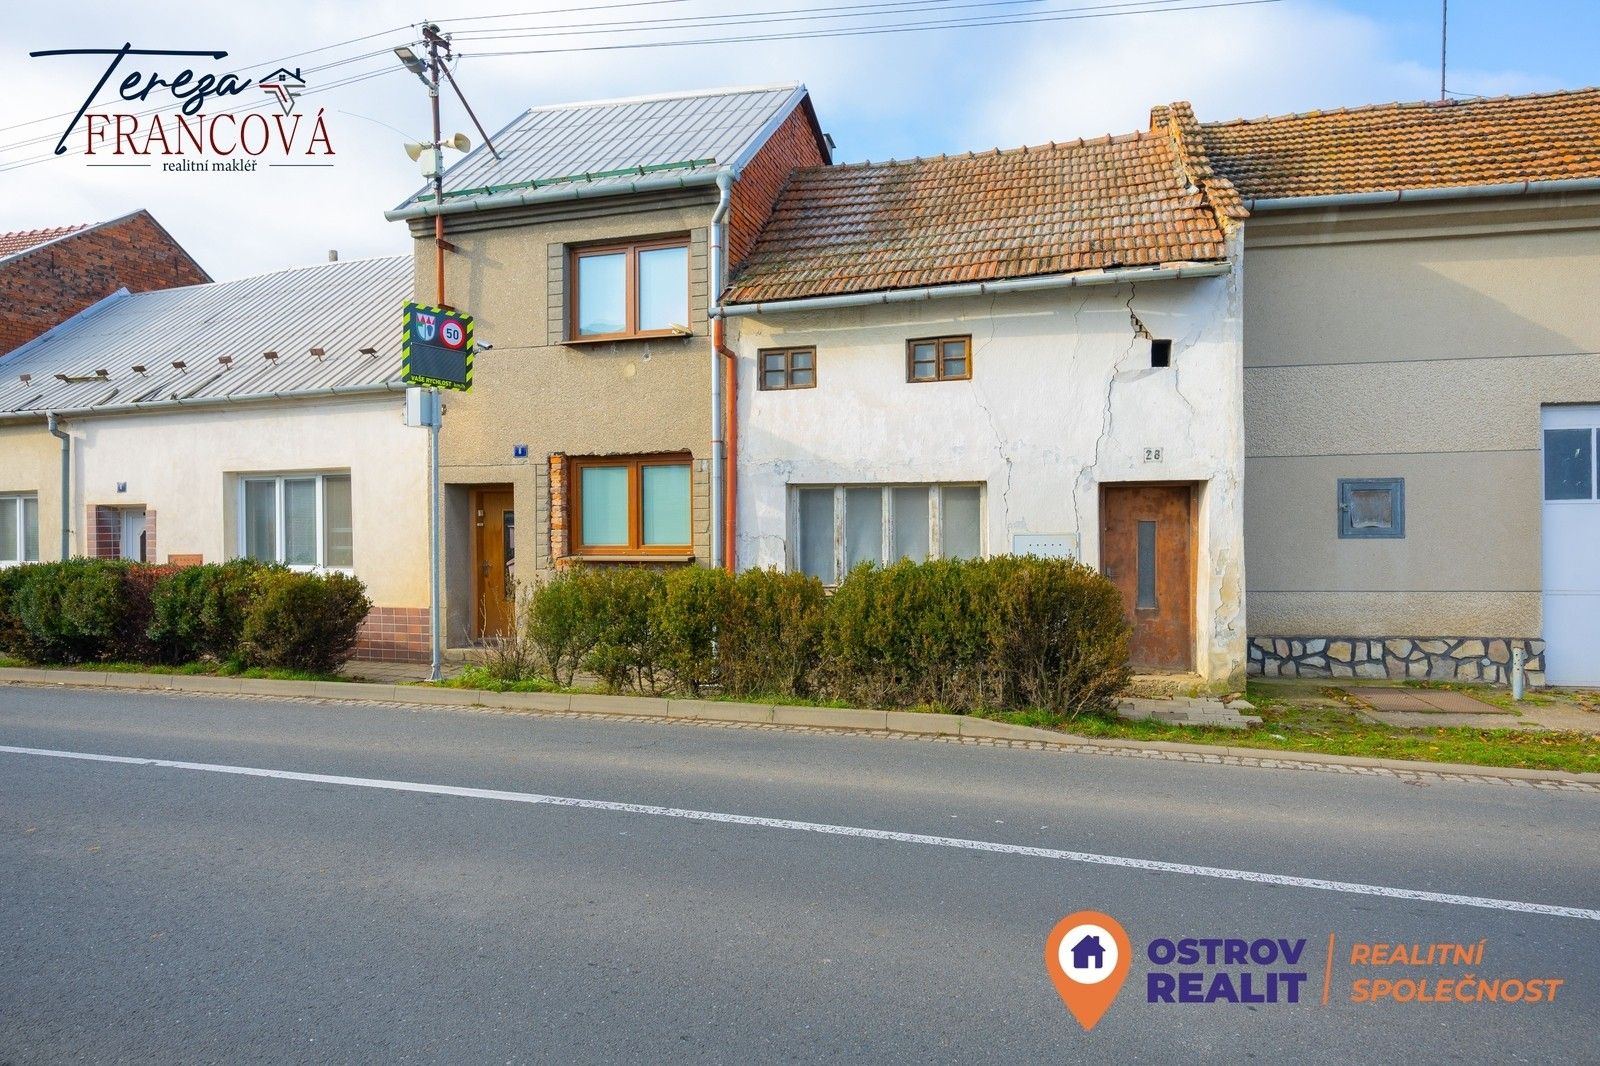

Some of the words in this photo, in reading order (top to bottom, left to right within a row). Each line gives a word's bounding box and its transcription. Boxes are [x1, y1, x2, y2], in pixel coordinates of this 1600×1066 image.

[446, 328, 459, 340] 50
[411, 375, 425, 383] VAŠE
[1145, 449, 1160, 460] 28
